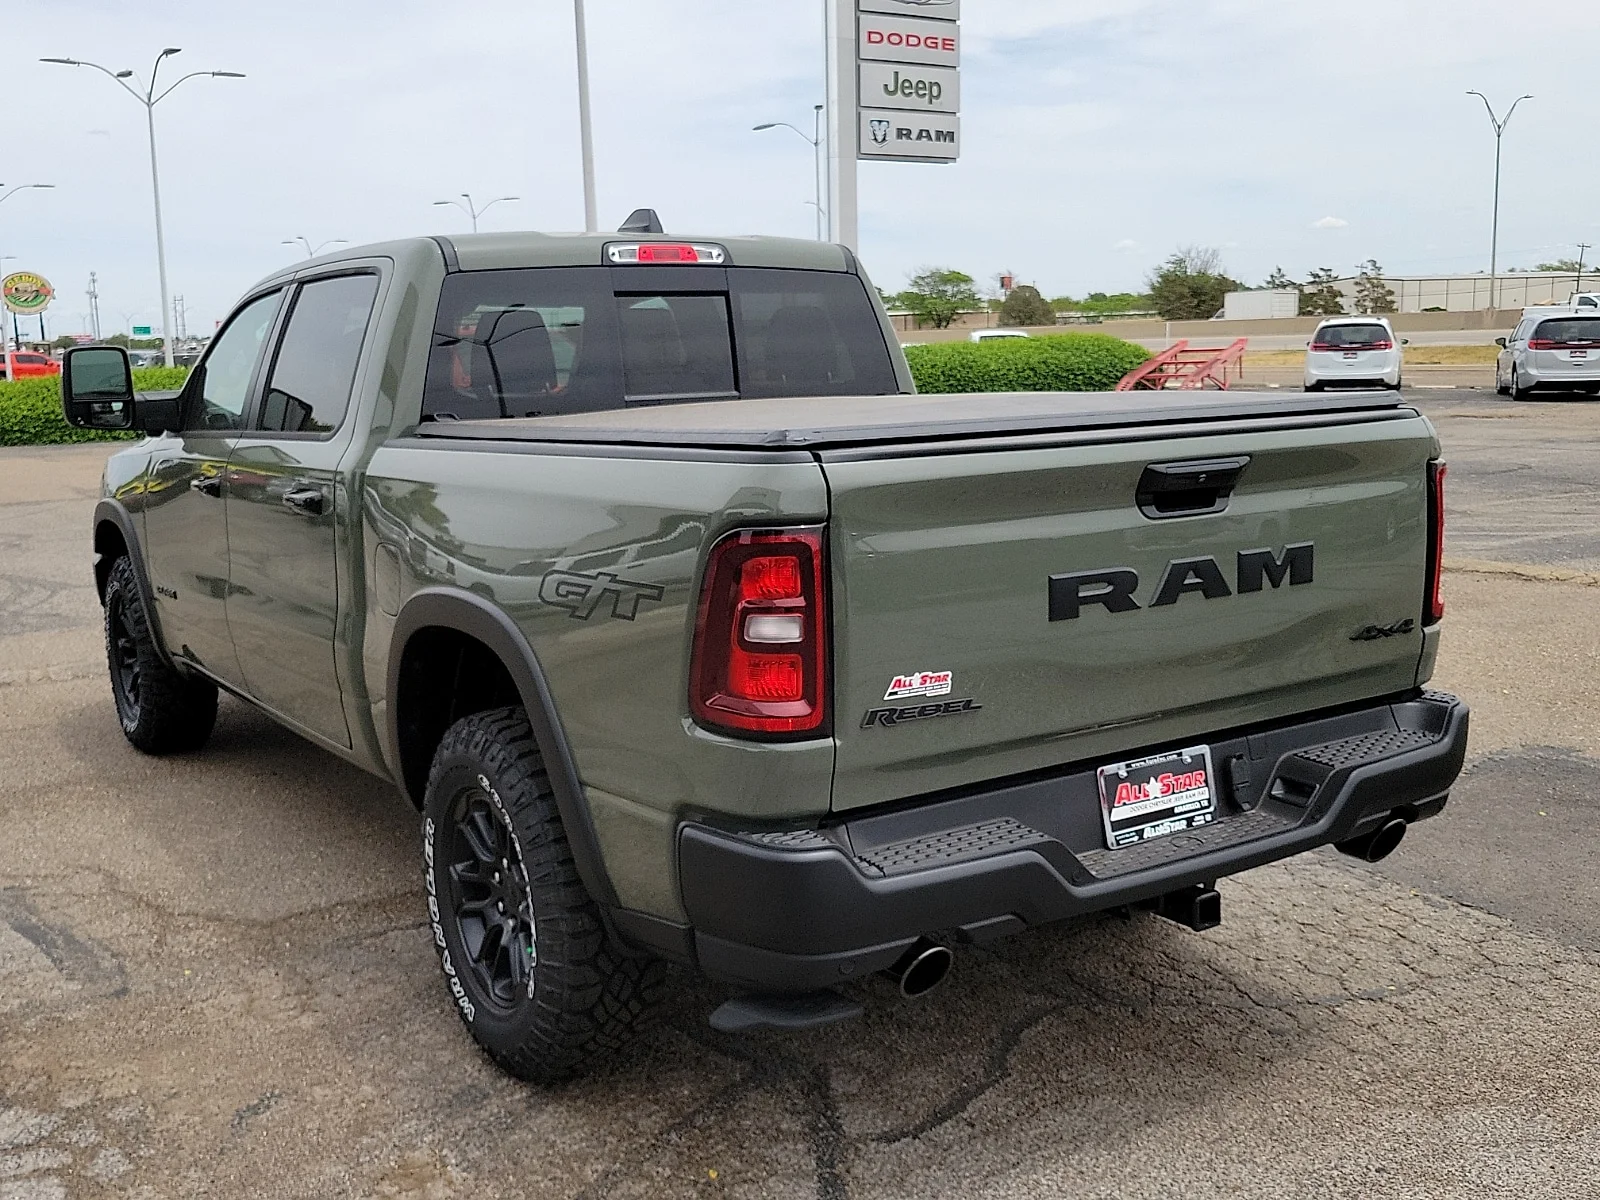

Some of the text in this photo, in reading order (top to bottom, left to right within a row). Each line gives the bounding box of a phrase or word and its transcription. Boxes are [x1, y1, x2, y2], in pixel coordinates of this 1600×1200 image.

[867, 31, 955, 51] DODGE
[883, 71, 942, 104] Jeep
[896, 127, 955, 143] RAM
[1048, 540, 1315, 622] RAM
[860, 698, 983, 728] REBEL
[424, 817, 476, 1023] WRANGLER
